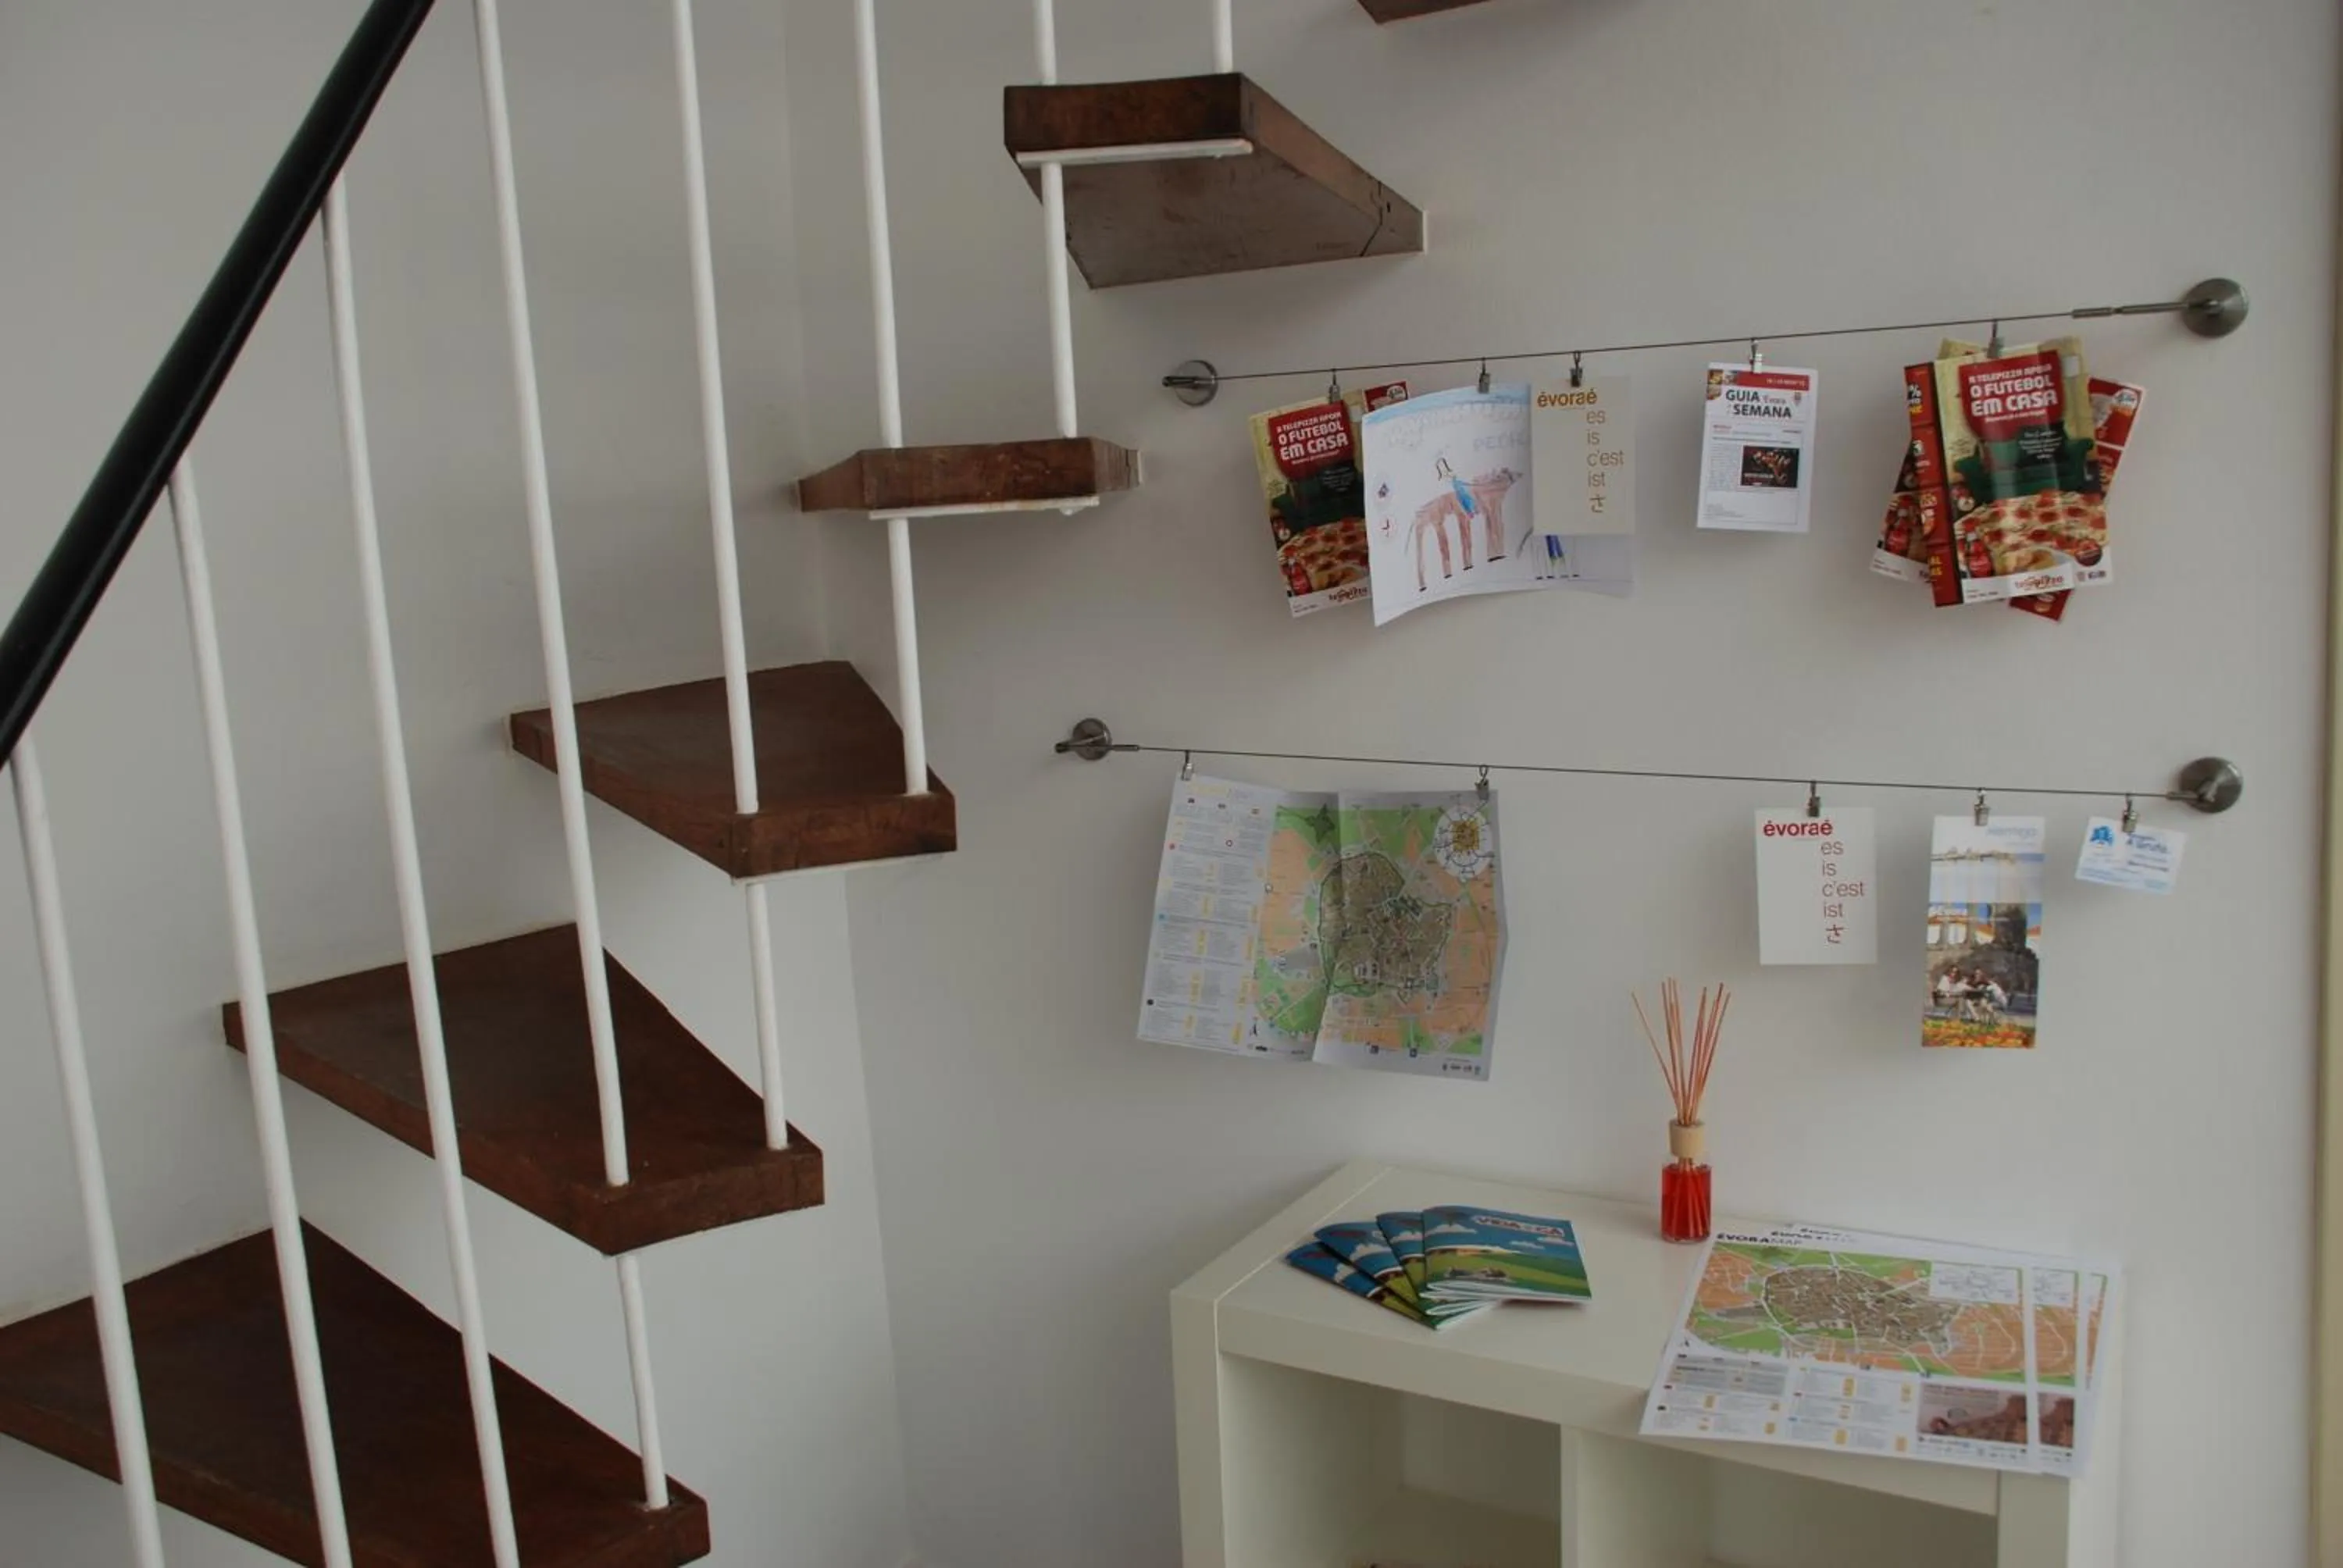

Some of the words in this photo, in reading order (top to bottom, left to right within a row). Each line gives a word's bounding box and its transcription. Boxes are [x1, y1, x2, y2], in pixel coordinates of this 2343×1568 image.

[1970, 384, 1982, 398] O
[1984, 375, 2055, 397] FUTEBOL
[1537, 388, 1597, 408] évoraé
[1726, 389, 1760, 402] GUIA
[1971, 397, 2002, 416] EM
[2006, 389, 2059, 412] CASA
[1586, 410, 1606, 425] es
[1733, 404, 1792, 419] SEMANA
[1278, 433, 1287, 445] O
[1288, 420, 1344, 443] FUTEBOL
[1587, 430, 1600, 445] is
[1280, 443, 1305, 461] EM
[1307, 433, 1349, 454] CASA
[1586, 450, 1624, 467] c'est
[1588, 471, 1606, 487] ist
[1763, 820, 1833, 837] évoraé
[1821, 840, 1844, 856] es
[1822, 861, 1837, 877] is
[1822, 881, 1865, 897] c'est
[1824, 901, 1843, 918] ist
